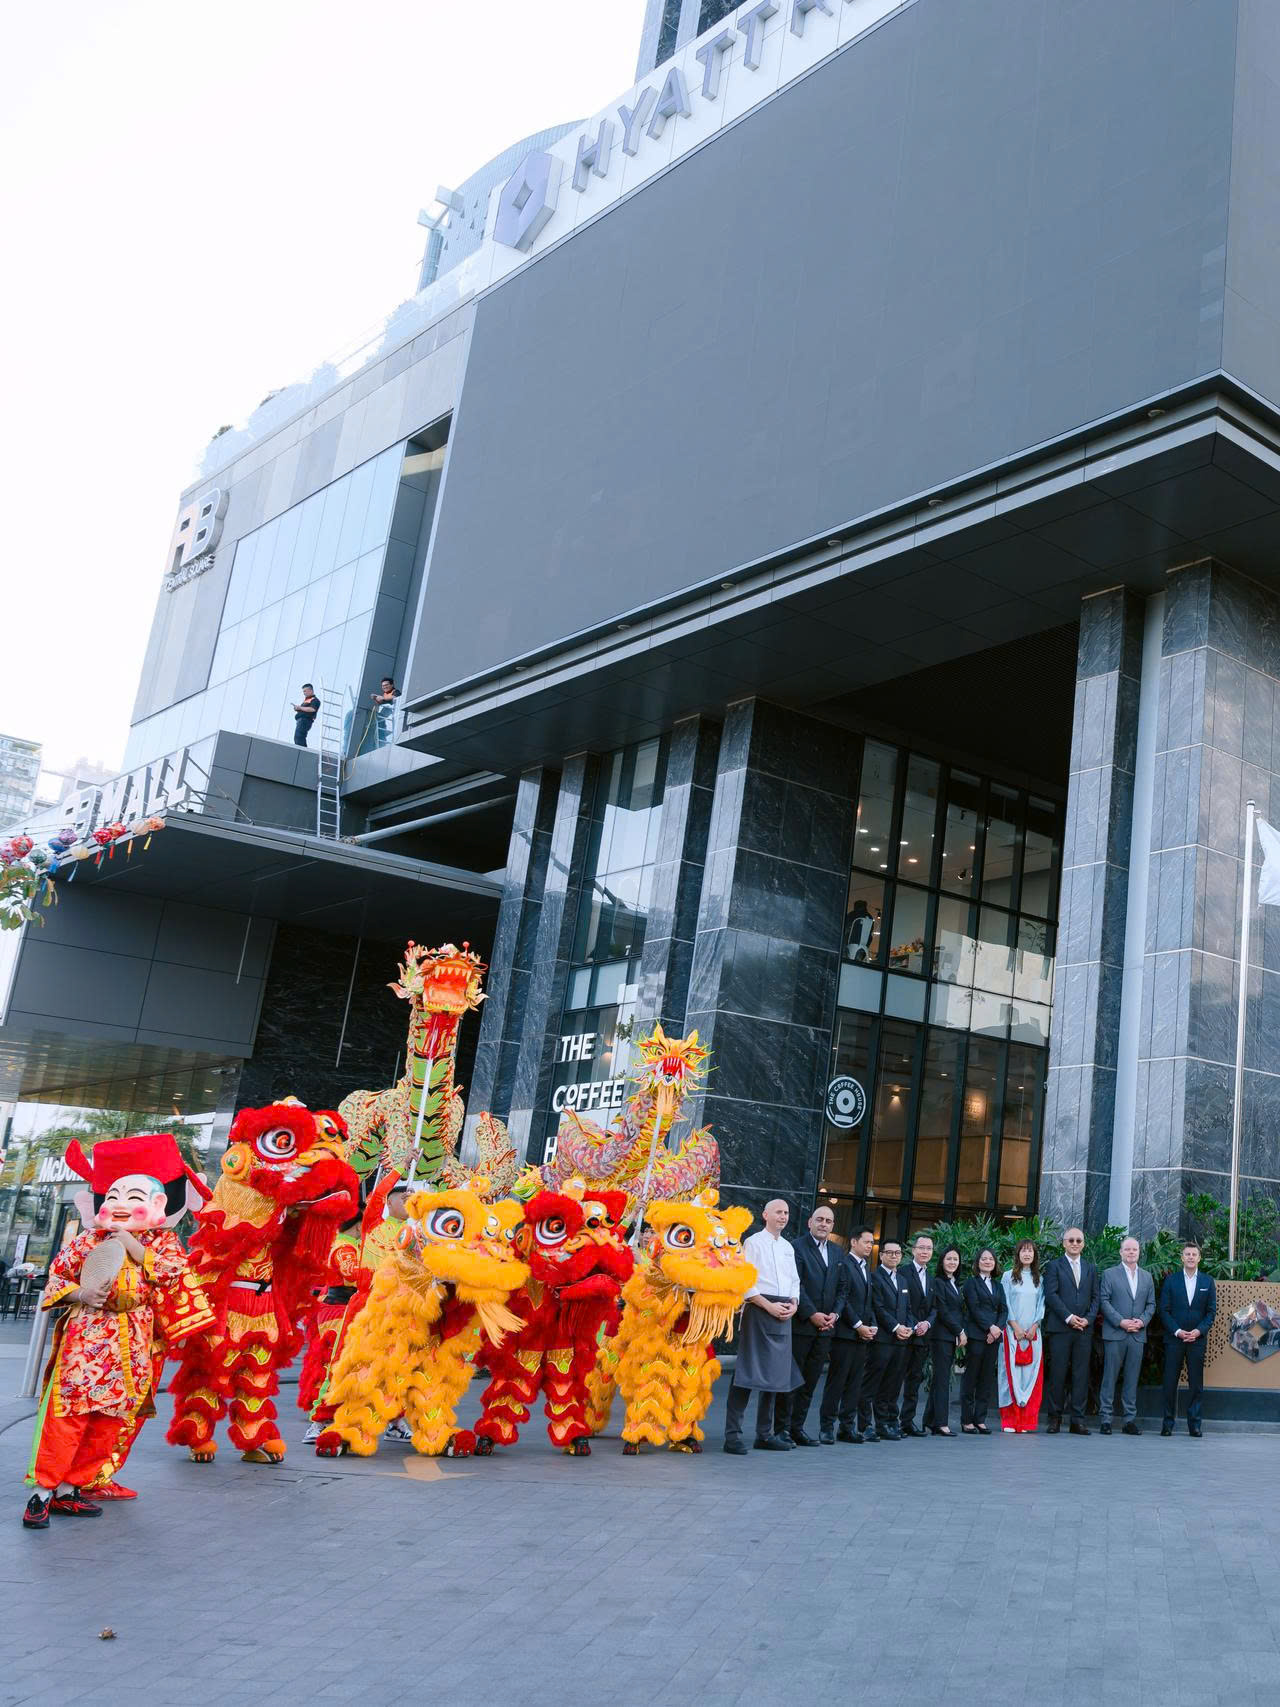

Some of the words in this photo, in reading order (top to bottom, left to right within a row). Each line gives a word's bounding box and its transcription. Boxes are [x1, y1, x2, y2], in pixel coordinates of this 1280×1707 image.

[571, 0, 780, 193] HYATT
[96, 748, 189, 828] MALL
[561, 1032, 595, 1062] THE
[552, 1079, 625, 1113] COFFEE
